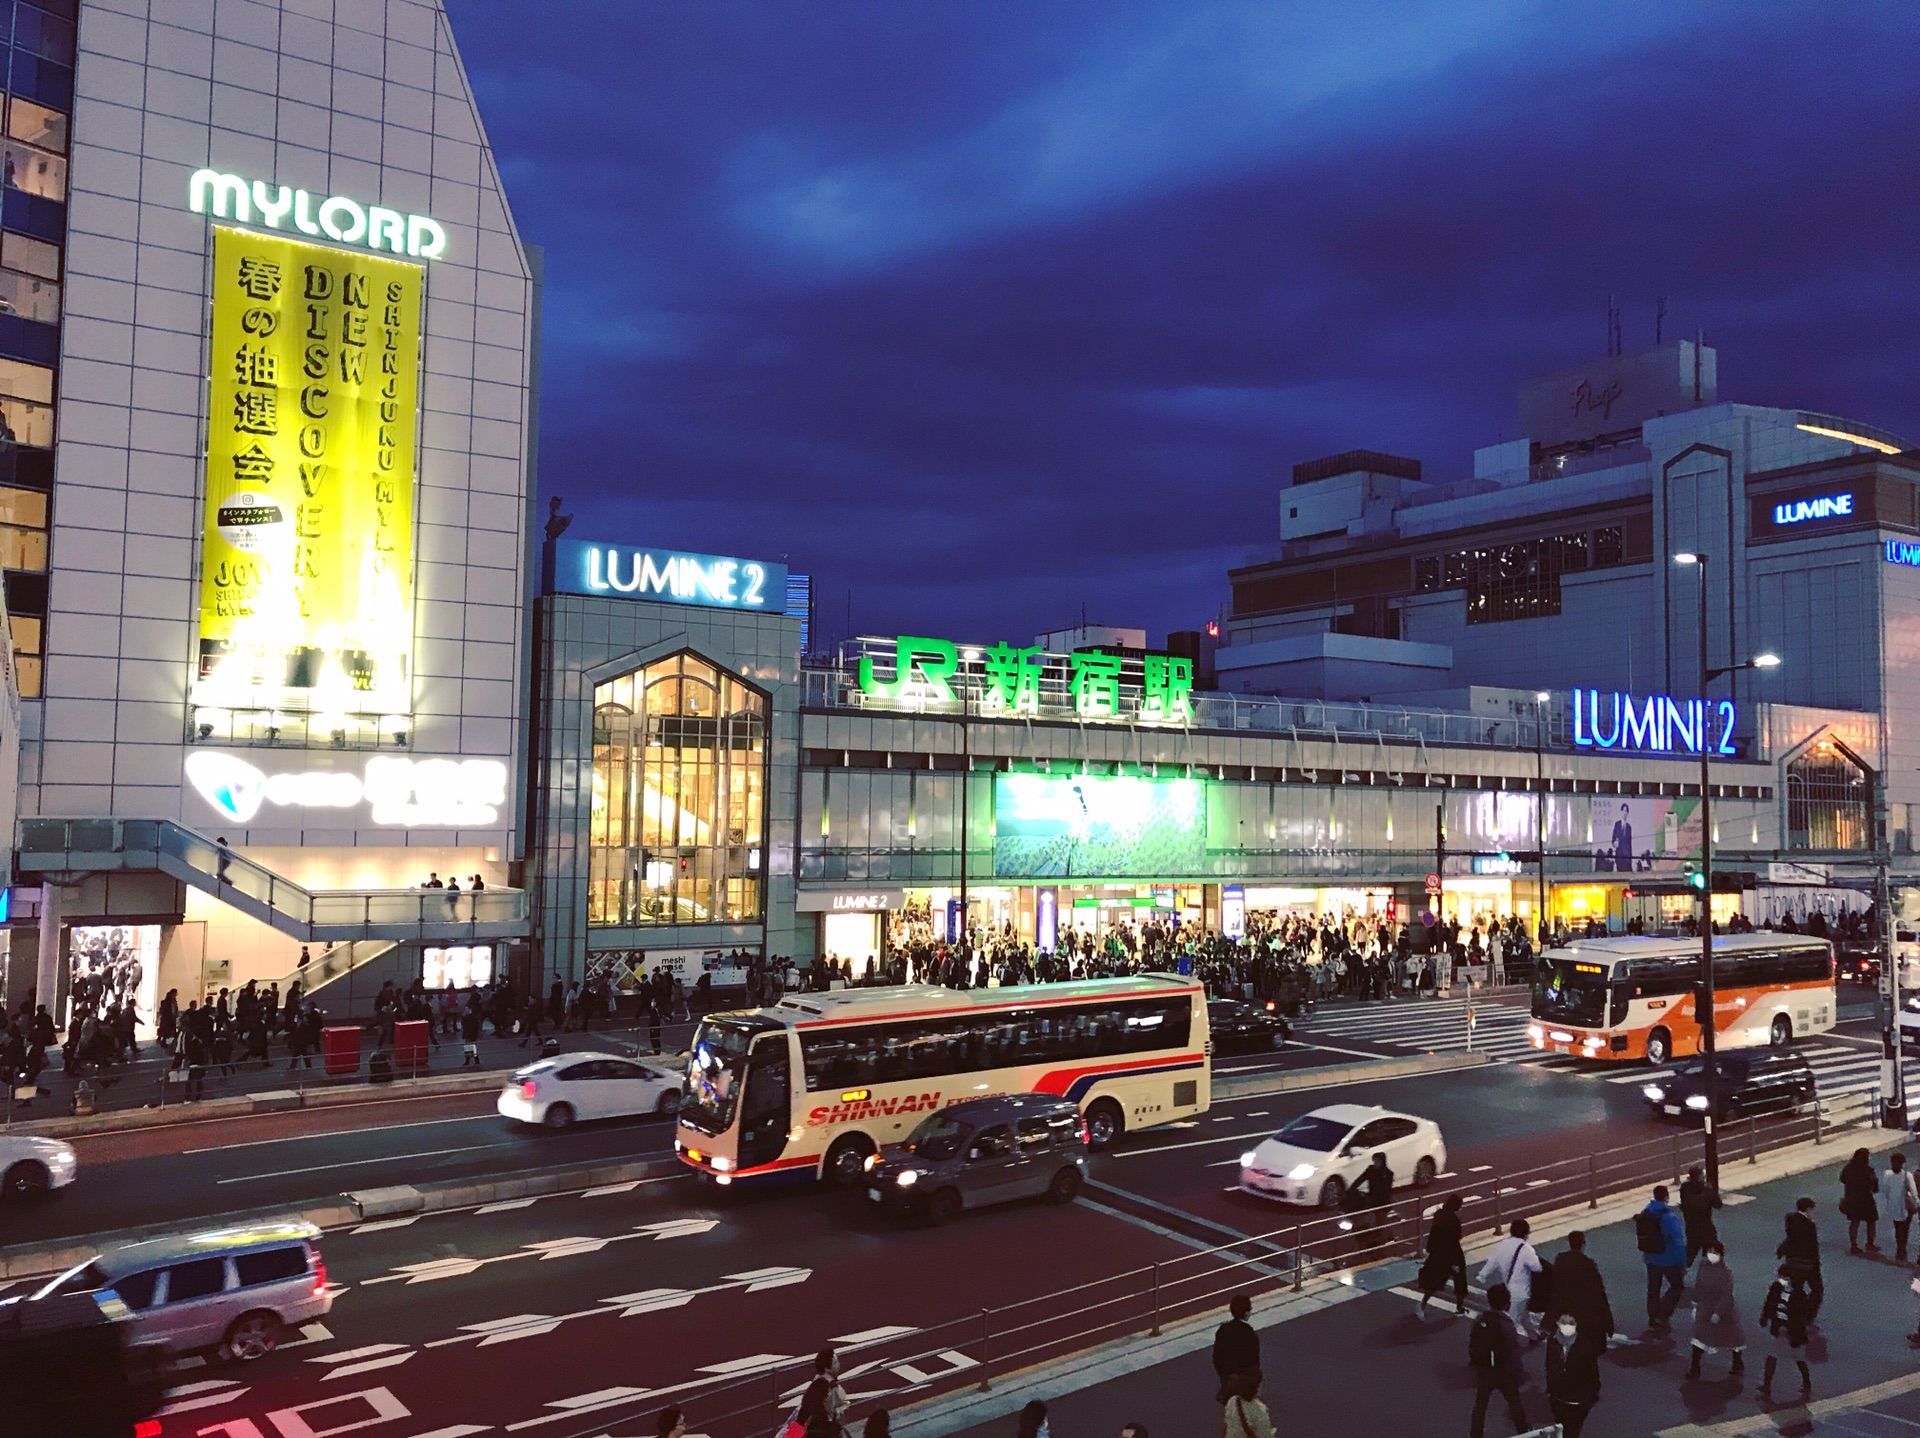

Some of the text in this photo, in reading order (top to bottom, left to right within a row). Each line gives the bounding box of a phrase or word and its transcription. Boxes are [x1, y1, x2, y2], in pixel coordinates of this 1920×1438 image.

[189, 168, 447, 260] MYLORD
[340, 272, 371, 386] NEW
[232, 256, 283, 484] 春の抽選会
[377, 281, 403, 471] SHINJUKU
[293, 265, 333, 618] DISCOVERY
[1775, 493, 1852, 524] LUMINE
[588, 547, 765, 604] LUMINE 2
[1573, 688, 1737, 755] LUMINE 2
[833, 895, 888, 909] LUMINE 2
[661, 955, 686, 965] meshi
[807, 1091, 941, 1127] SHINNAN
